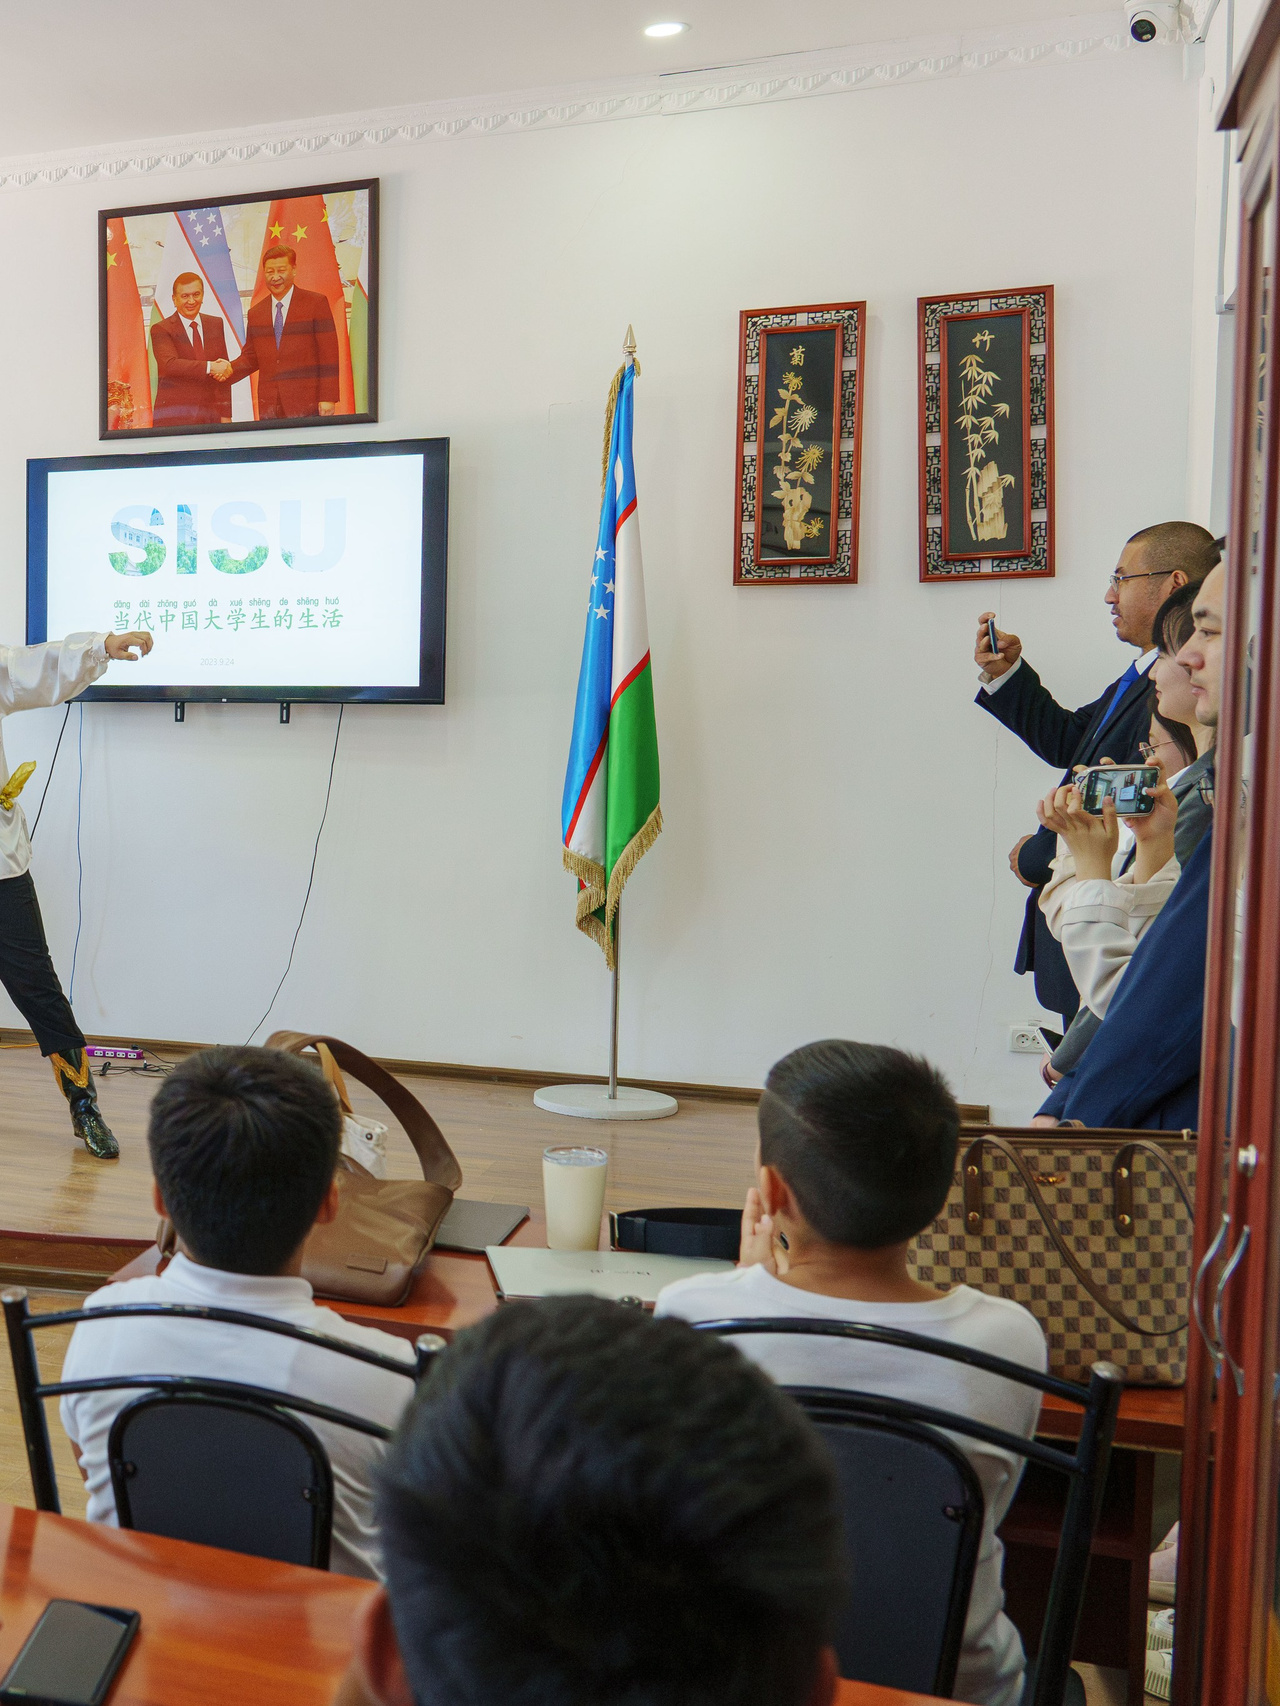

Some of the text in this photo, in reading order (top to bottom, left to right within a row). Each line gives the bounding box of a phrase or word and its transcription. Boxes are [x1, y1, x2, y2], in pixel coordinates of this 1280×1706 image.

[972, 329, 995, 351] 竹
[789, 345, 806, 366] 菊
[108, 497, 347, 576] SISU
[183, 599, 197, 609] guó
[208, 598, 218, 607] dà
[229, 598, 243, 607] xué
[249, 597, 271, 608] shēng
[279, 597, 289, 606] de
[296, 596, 320, 607] shēng
[325, 596, 340, 605] huó
[113, 607, 344, 633] 当代中国大学生的生活
